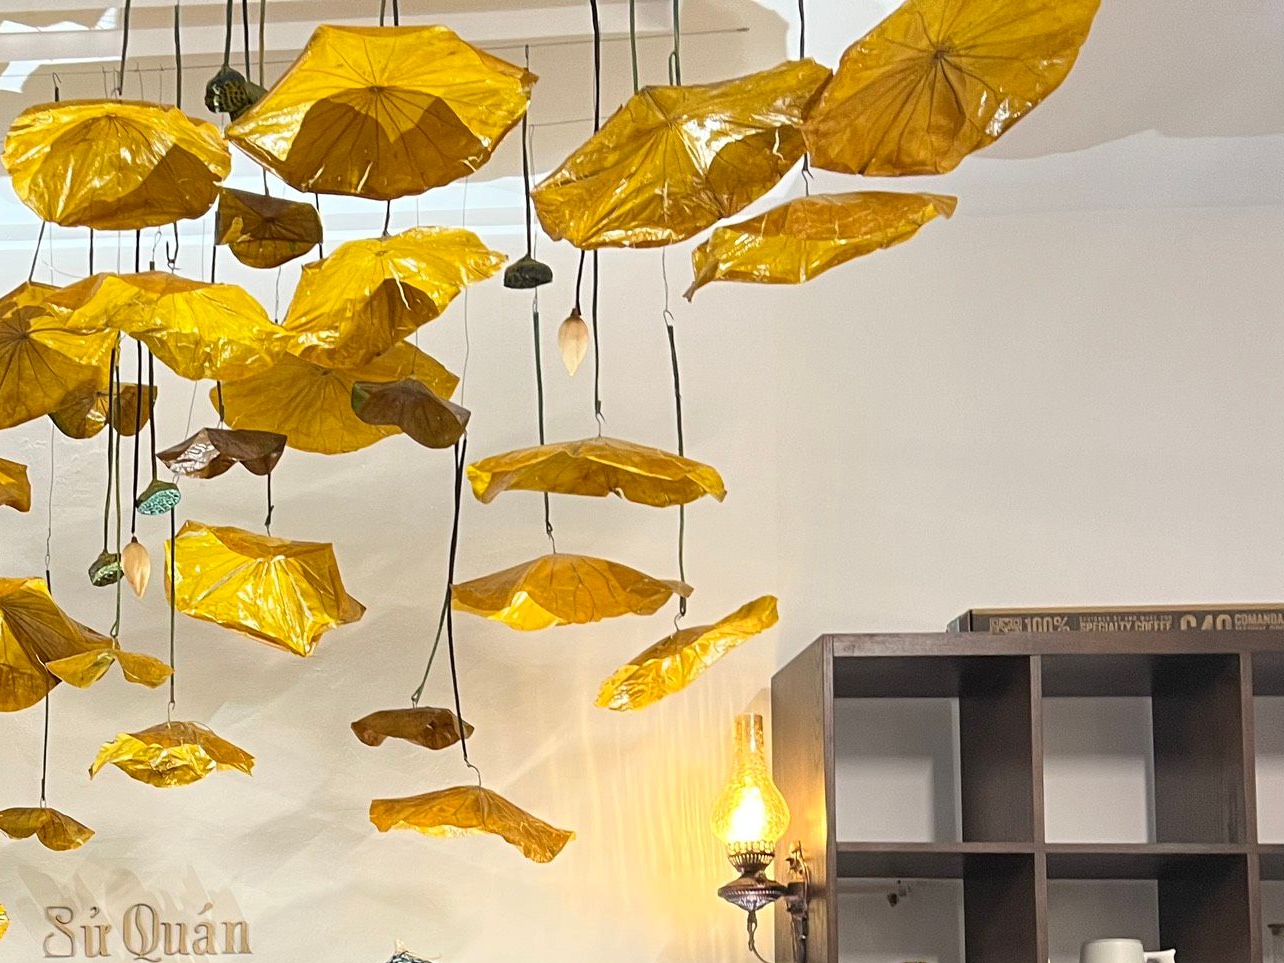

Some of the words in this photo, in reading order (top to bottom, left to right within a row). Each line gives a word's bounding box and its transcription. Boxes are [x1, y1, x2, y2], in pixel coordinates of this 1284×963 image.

[1024, 616, 1071, 632] 100%
[1079, 621, 1132, 632] SPECIALTY
[122, 903, 253, 963] Quán
